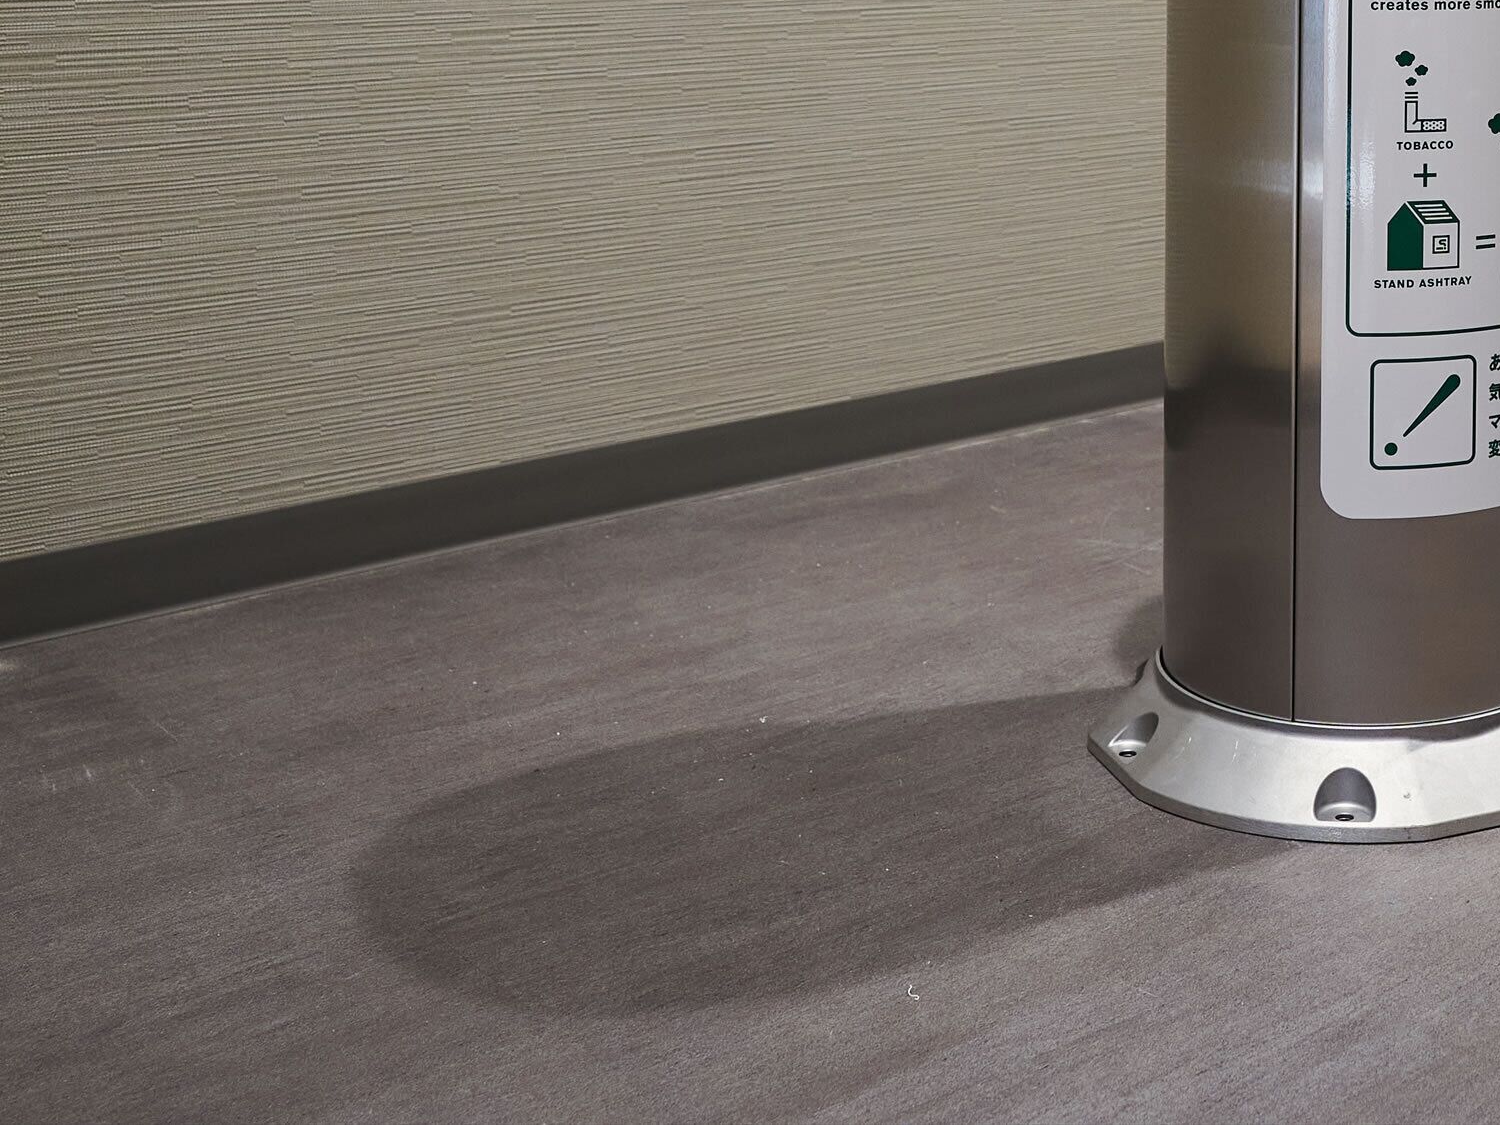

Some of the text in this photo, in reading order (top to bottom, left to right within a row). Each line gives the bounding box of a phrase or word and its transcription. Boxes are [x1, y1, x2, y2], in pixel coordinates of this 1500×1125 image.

[1371, 0, 1428, 10] creates
[1434, 0, 1470, 9] more
[1396, 141, 1454, 150] TOBACCO
[1374, 276, 1472, 289] STAND ASHTRAY
